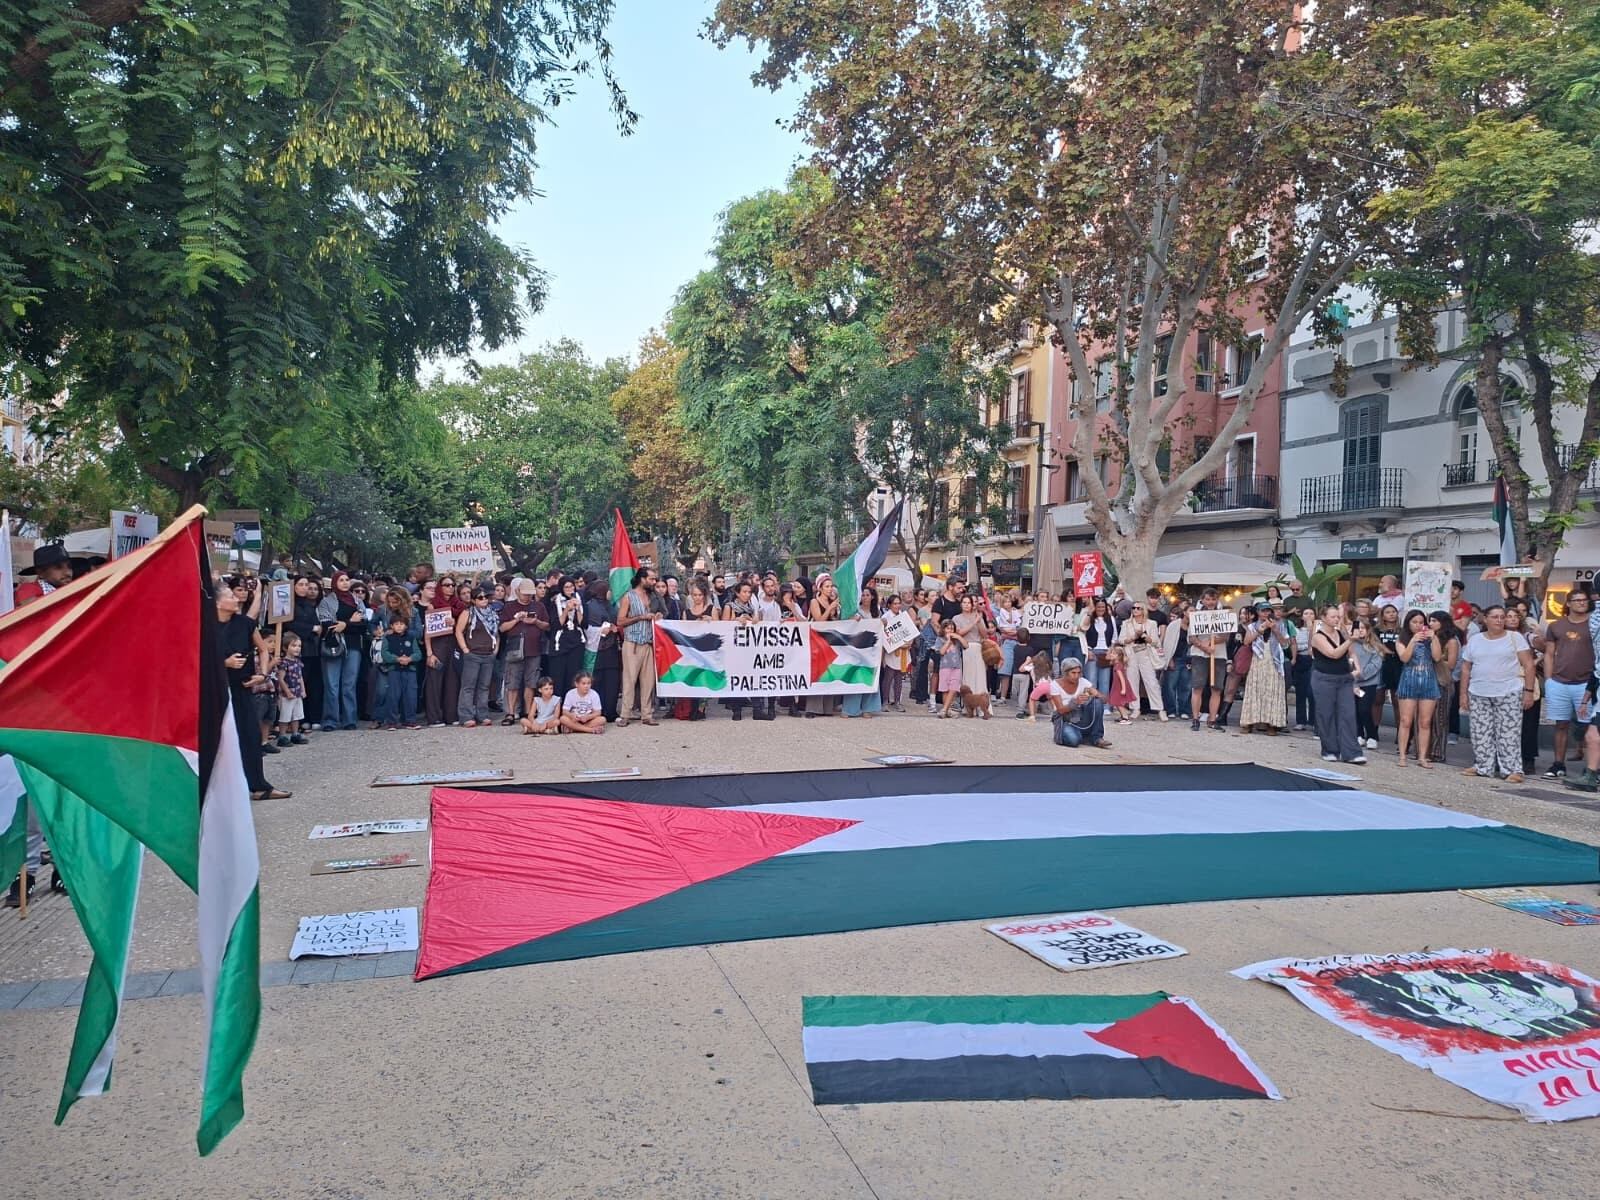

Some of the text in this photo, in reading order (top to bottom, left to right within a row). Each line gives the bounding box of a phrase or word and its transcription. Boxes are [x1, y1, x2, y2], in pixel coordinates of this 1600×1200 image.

[432, 528, 486, 540] NETANYAHU
[436, 541, 490, 554] CRIMINALS
[450, 557, 486, 568] TRUMP
[1028, 603, 1063, 618] STOP
[1194, 622, 1234, 634] HUMANITY
[734, 626, 803, 647] EIVISSA
[753, 653, 785, 669] AMB
[730, 674, 808, 691] PALESTINA
[1068, 944, 1176, 964] LEONARDO
